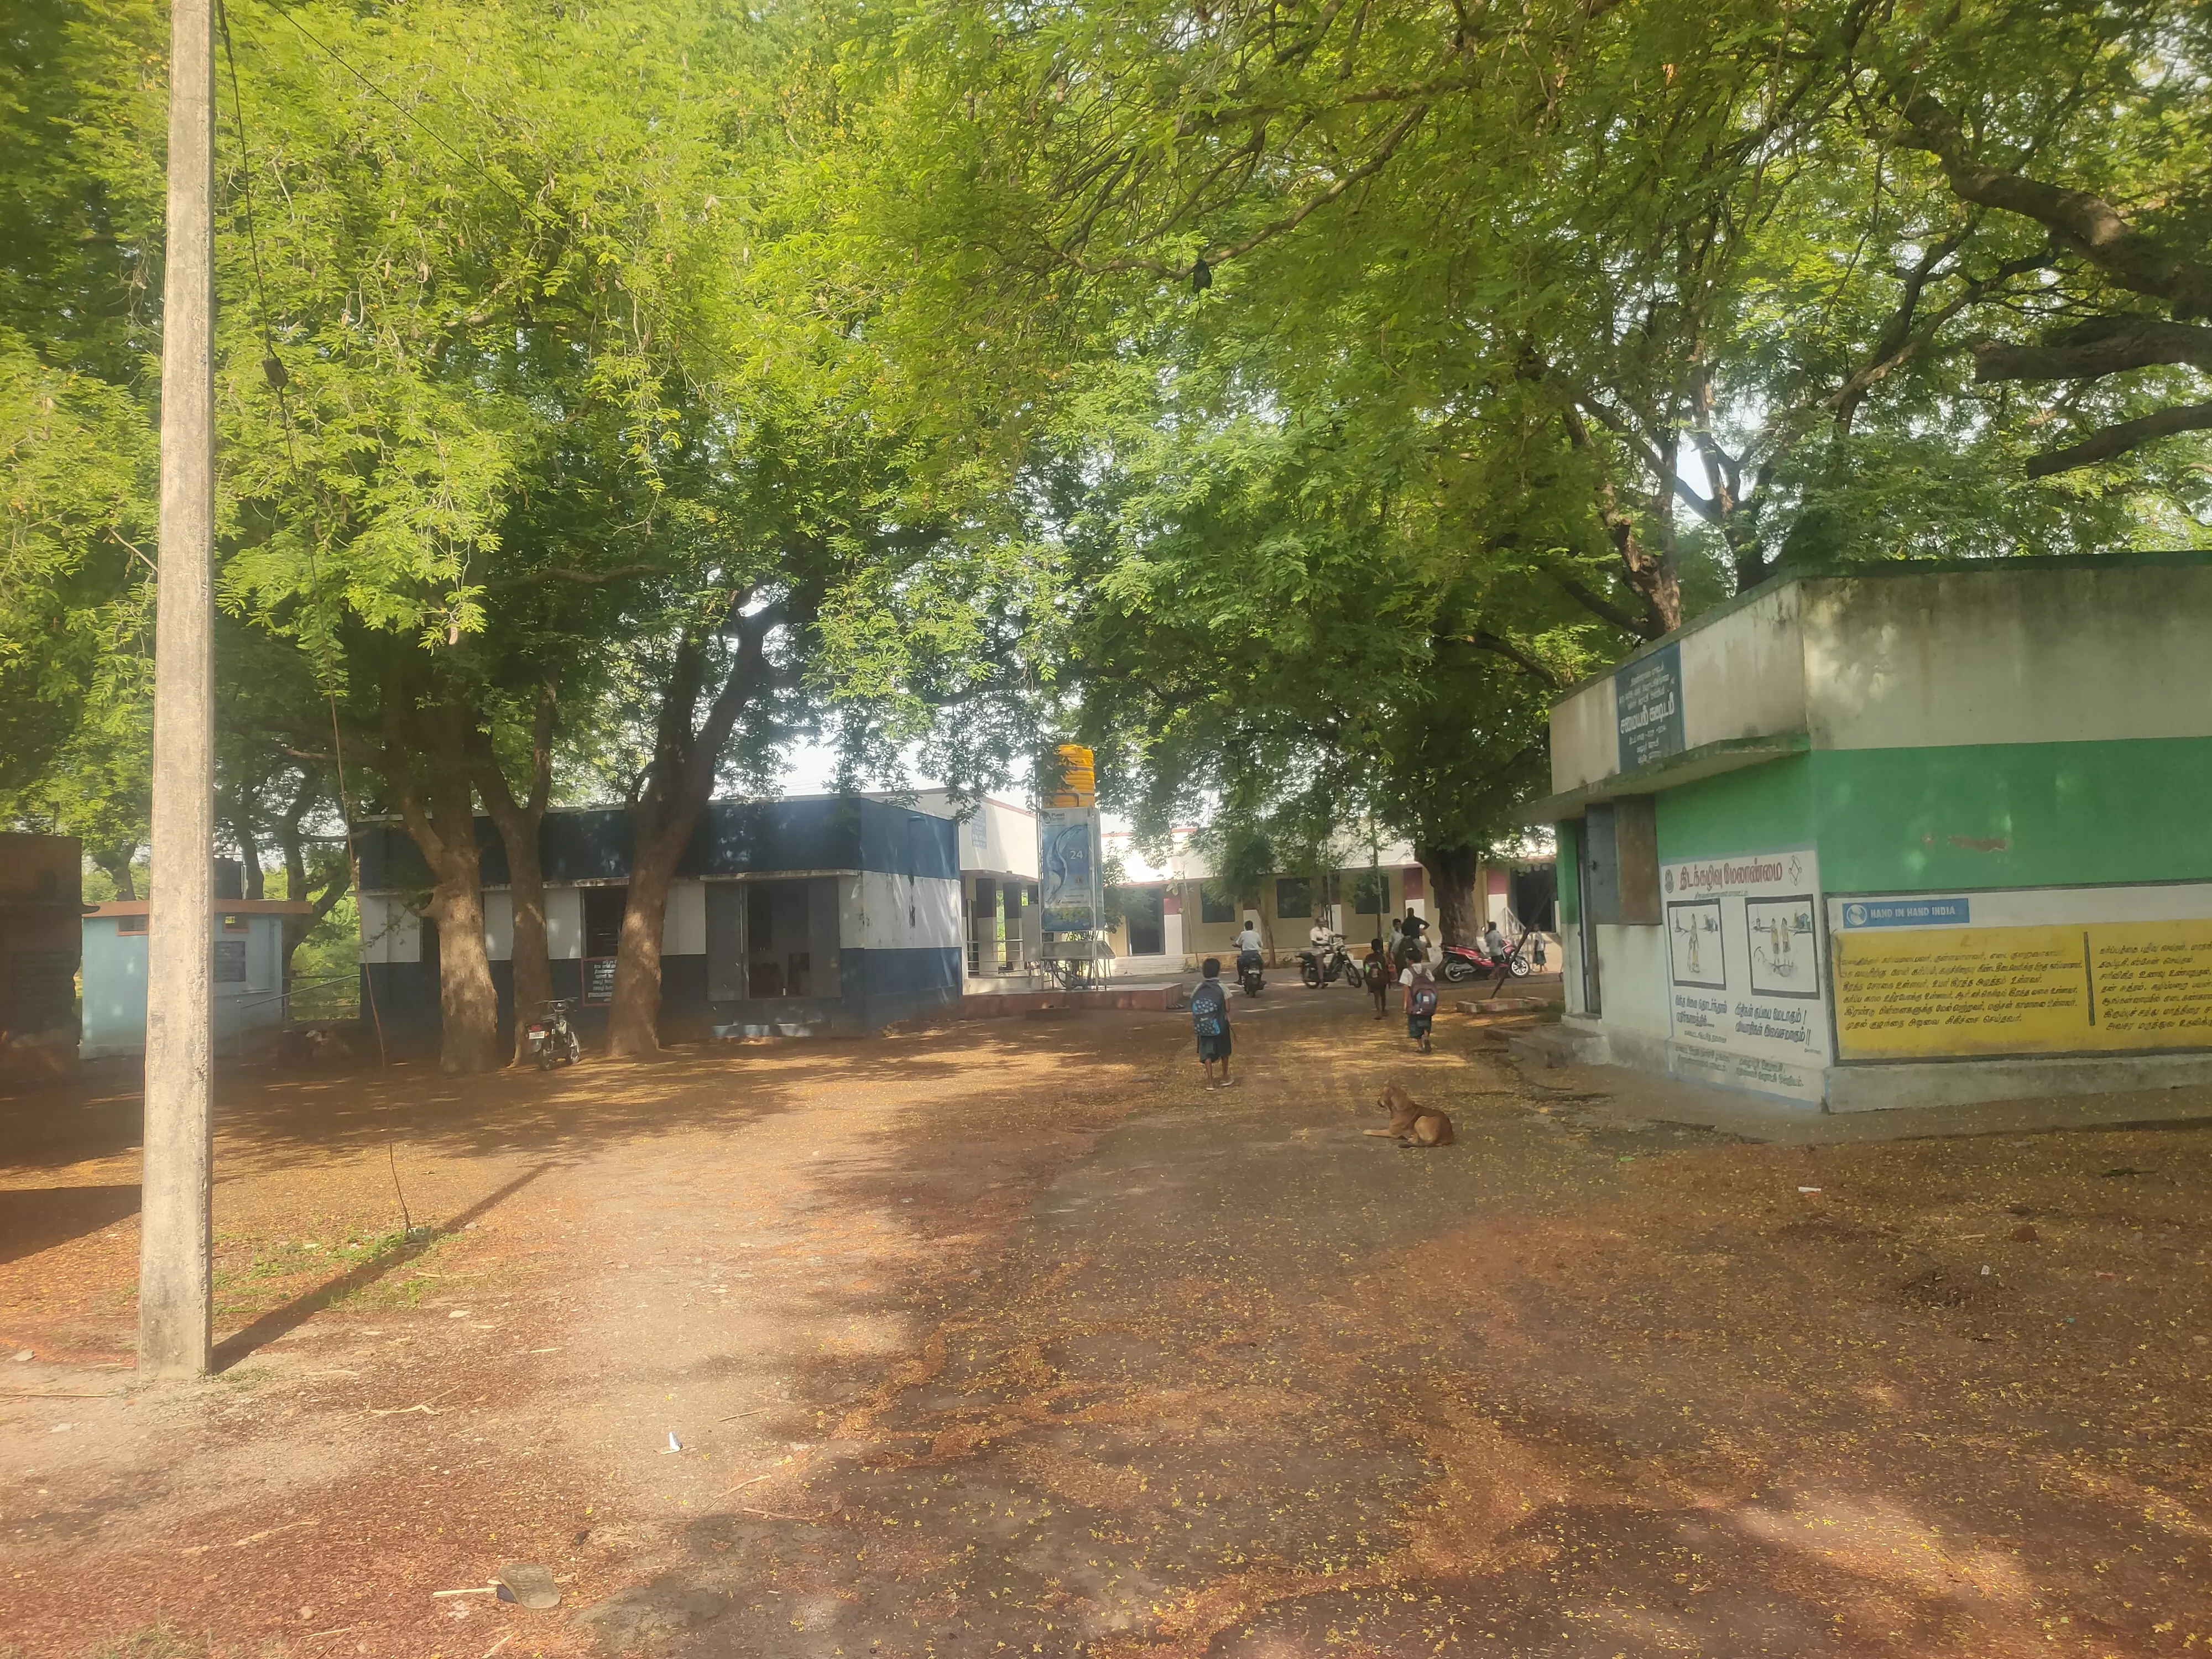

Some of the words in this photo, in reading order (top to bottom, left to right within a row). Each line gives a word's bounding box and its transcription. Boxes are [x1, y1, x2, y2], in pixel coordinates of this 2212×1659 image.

[1070, 850, 1083, 859] 24
[1679, 864, 1723, 891] திடக்கழிவு
[1724, 857, 1782, 884] மேலாண்மை
[1870, 909, 1892, 919] HAND
[1895, 908, 1905, 917] IN
[1907, 907, 1929, 916] HAND
[1932, 906, 1956, 916] INDIA
[1844, 1006, 1875, 1018] இரண்டு
[1845, 1019, 1867, 1030] முதல்
